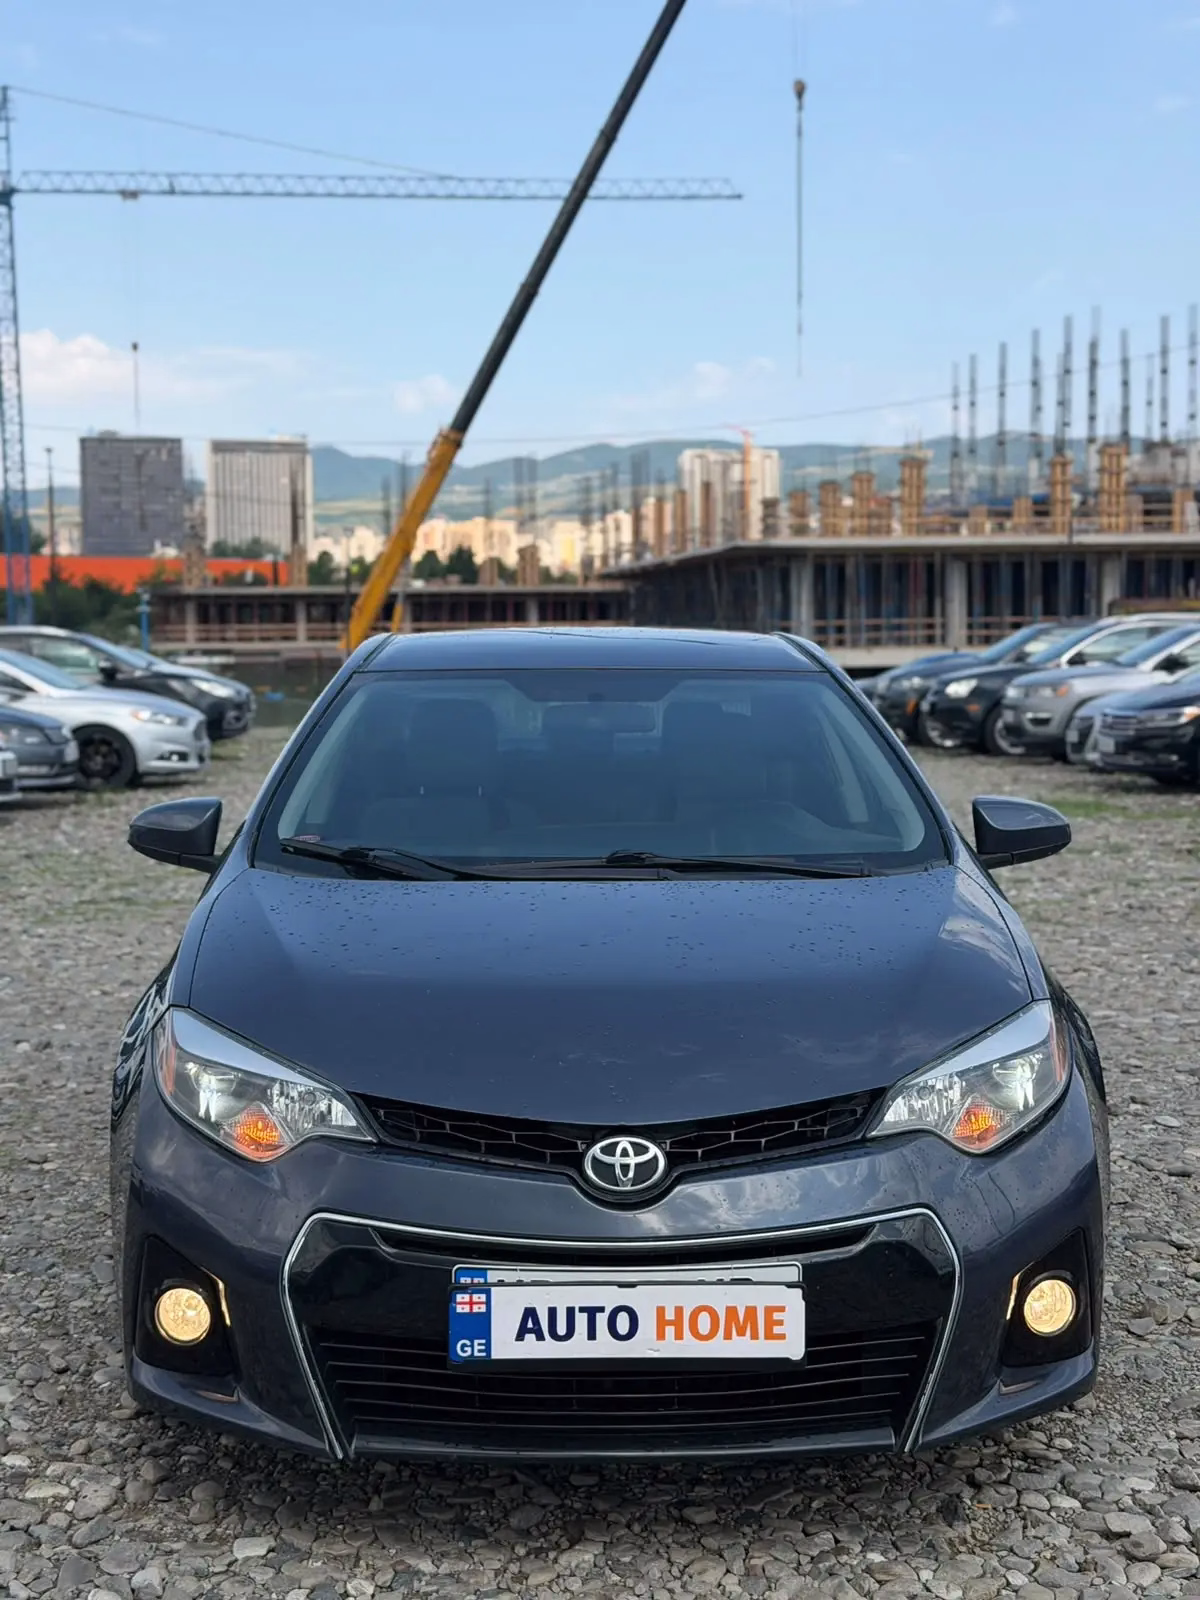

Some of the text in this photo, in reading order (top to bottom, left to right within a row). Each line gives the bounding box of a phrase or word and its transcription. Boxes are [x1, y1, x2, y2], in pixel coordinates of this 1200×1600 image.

[514, 1305, 787, 1342] AUTO HOME
[456, 1339, 487, 1357] GE
